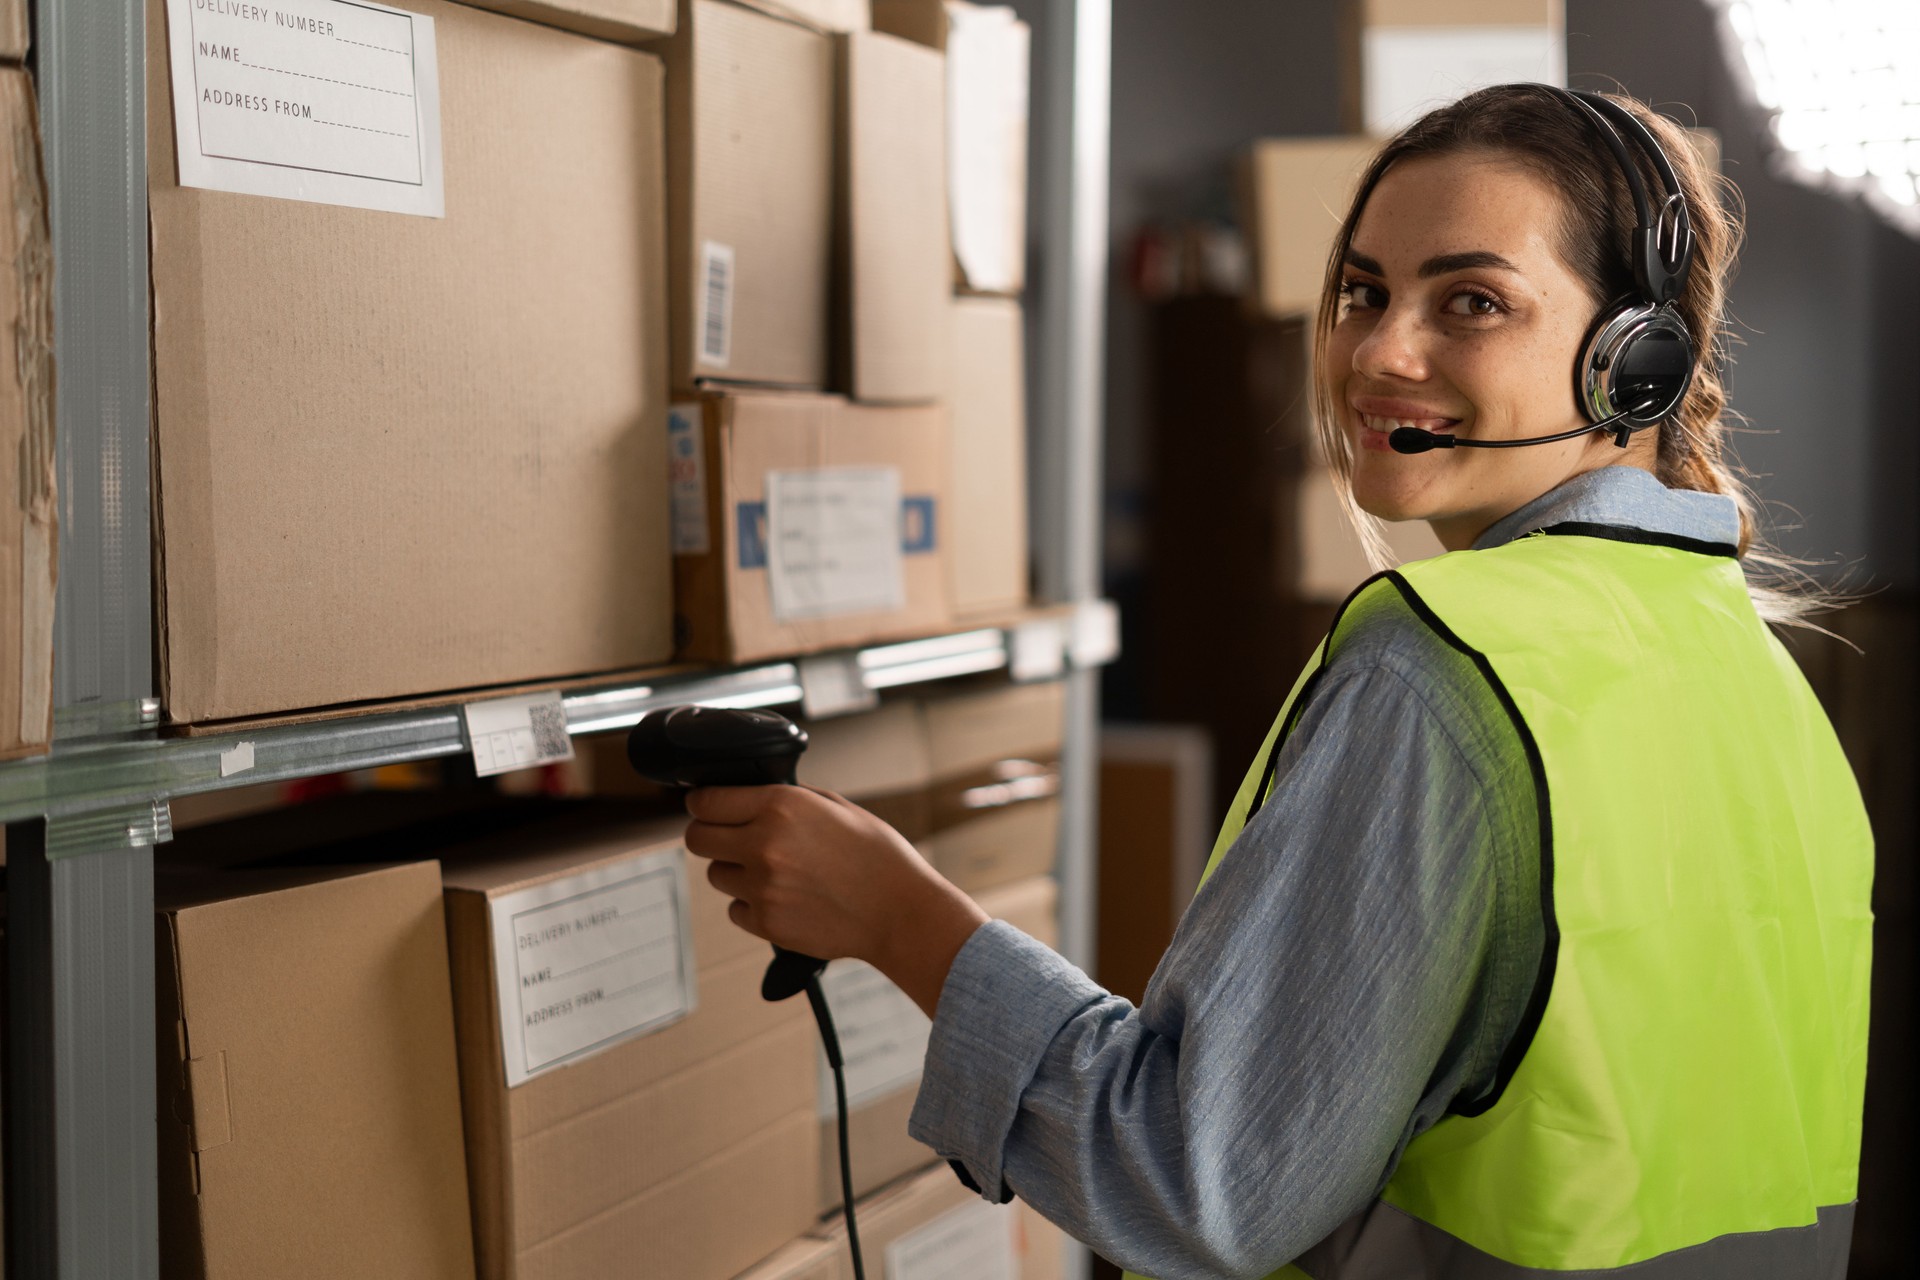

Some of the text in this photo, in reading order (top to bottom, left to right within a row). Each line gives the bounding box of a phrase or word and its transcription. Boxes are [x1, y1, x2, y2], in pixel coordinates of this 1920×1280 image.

[197, 0, 334, 37] DELIVERY NUMBER
[199, 41, 240, 63] NAME
[203, 88, 312, 119] ADDRESS FROM
[519, 922, 571, 950] DELIVERY
[523, 967, 551, 988] NAME
[526, 999, 573, 1026] ADDRESS
